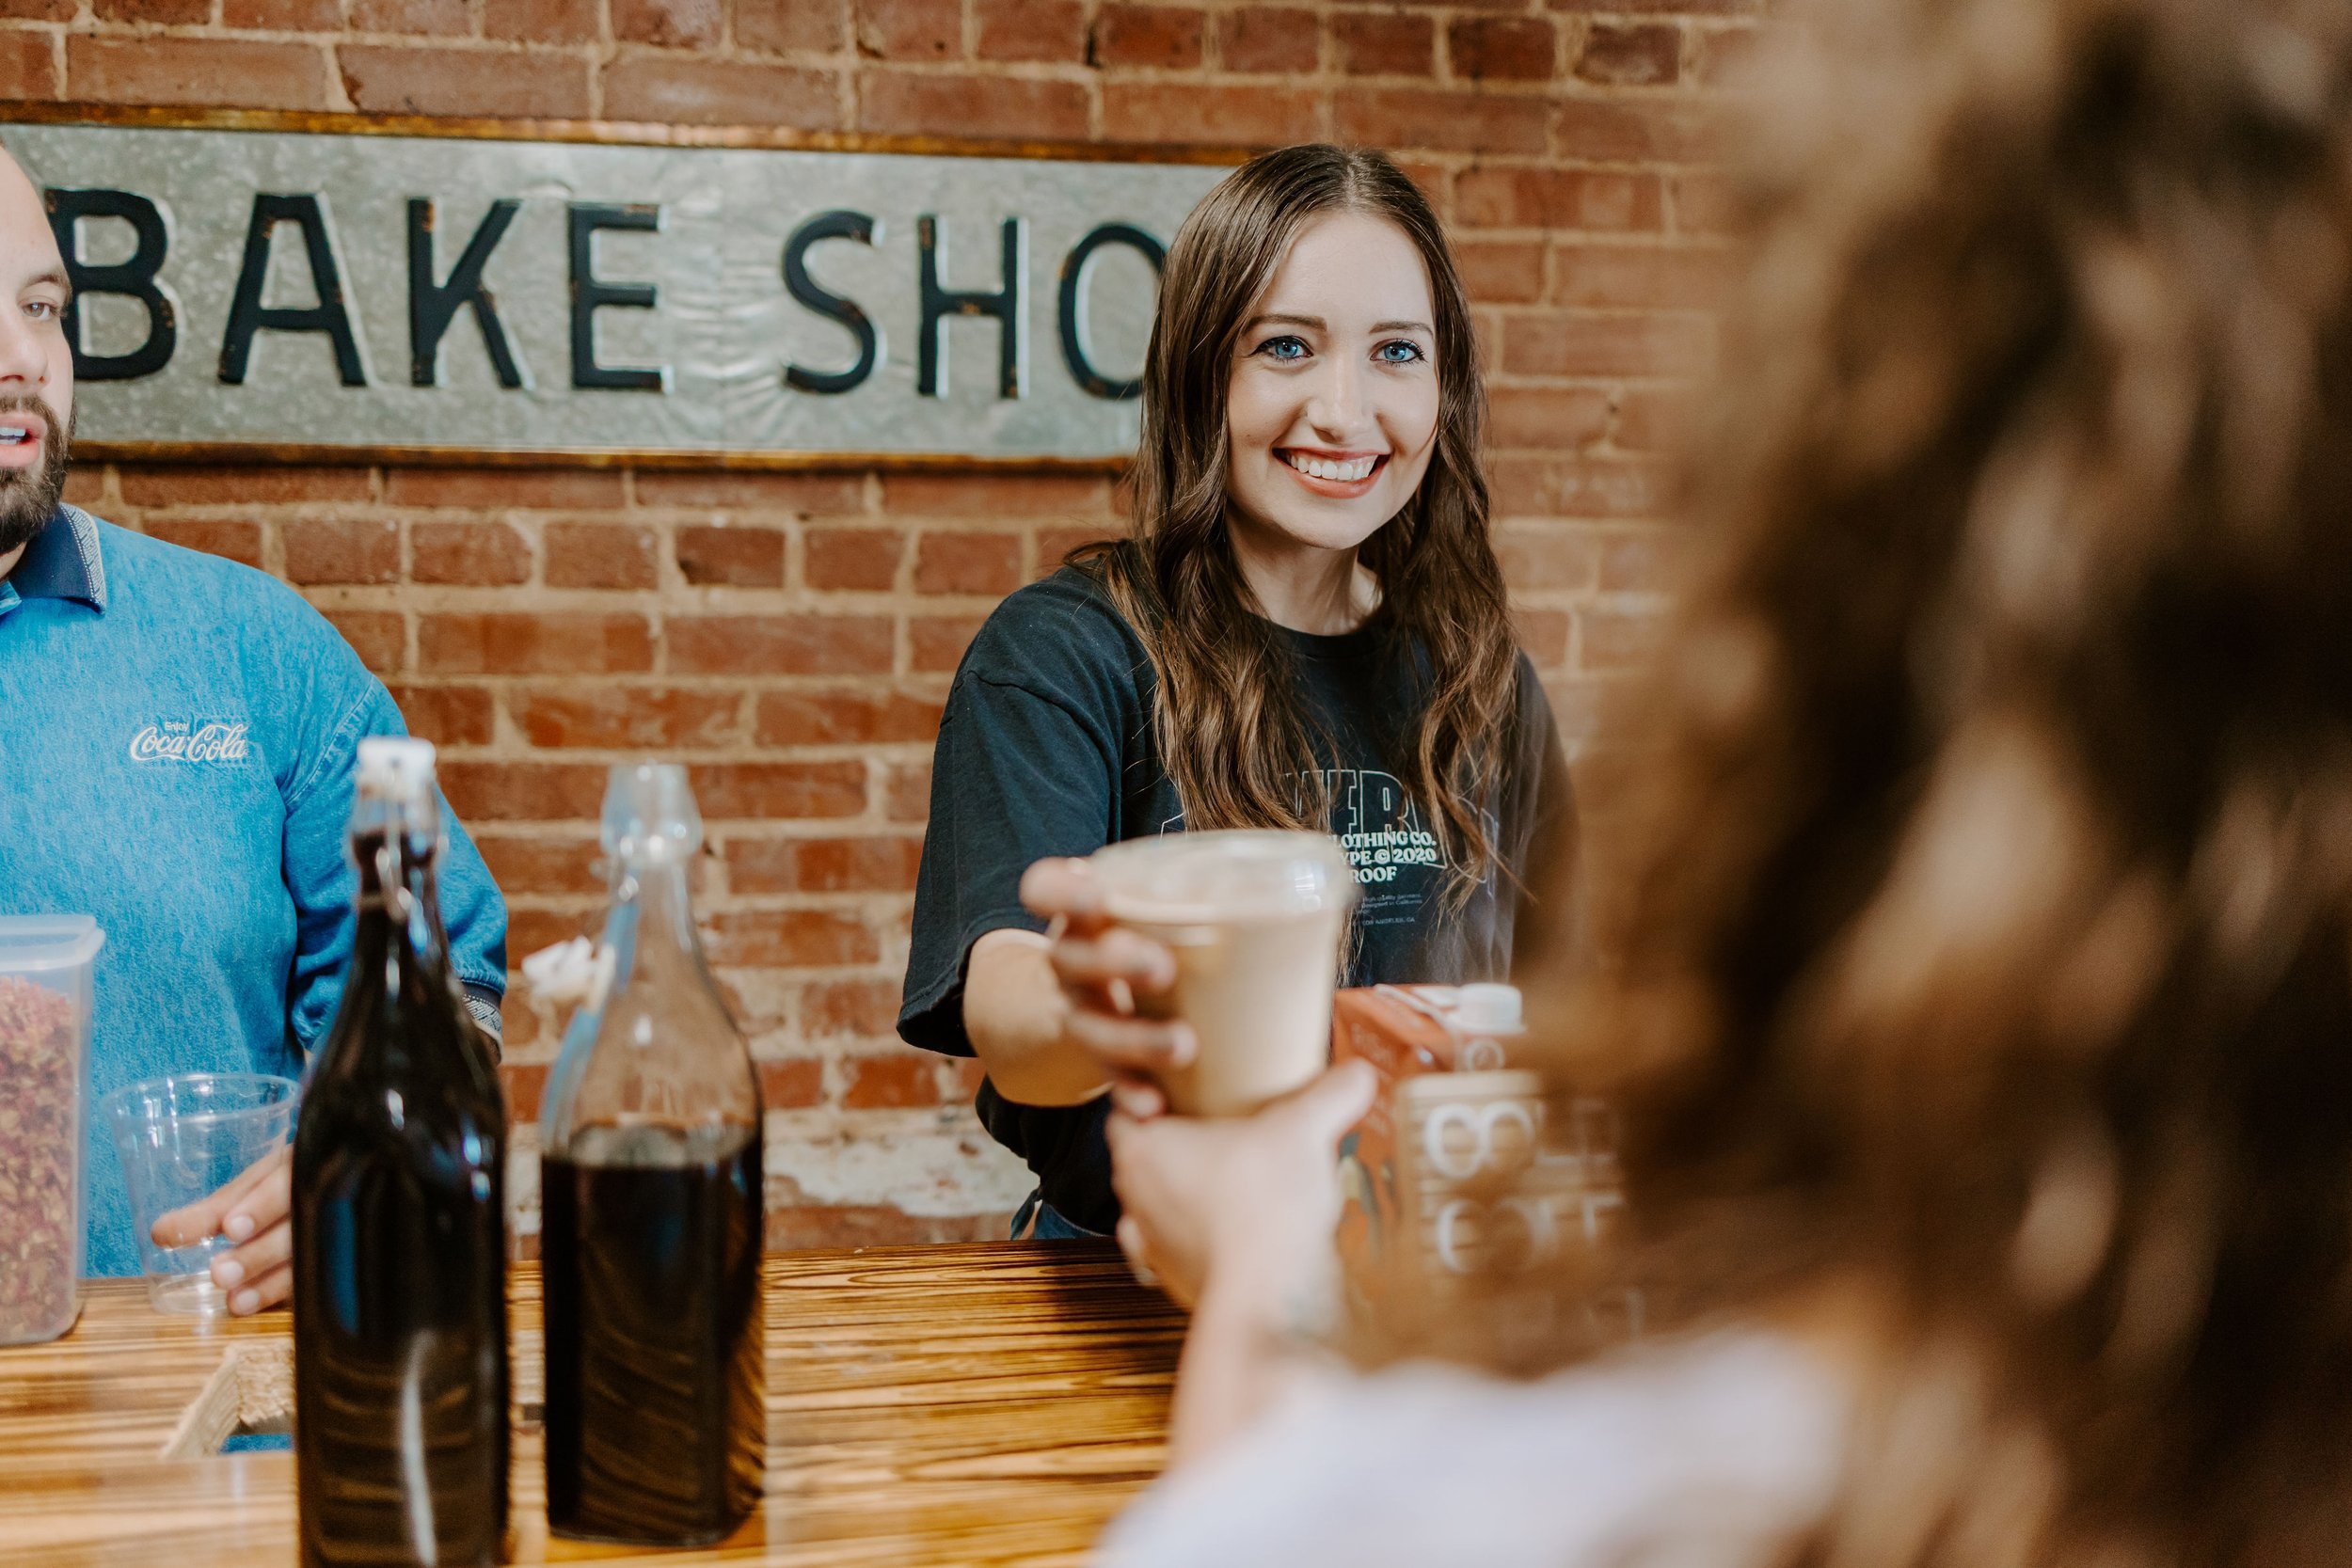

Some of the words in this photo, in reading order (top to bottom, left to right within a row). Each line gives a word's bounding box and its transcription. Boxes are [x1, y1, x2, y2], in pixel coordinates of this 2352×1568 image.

[44, 187, 662, 389] BAKE
[782, 209, 1169, 399] SHO
[164, 721, 189, 733] Enjoy
[130, 722, 249, 762] Coca-Cola
[1409, 832, 1438, 847] CO.
[1392, 847, 1437, 863] 2020
